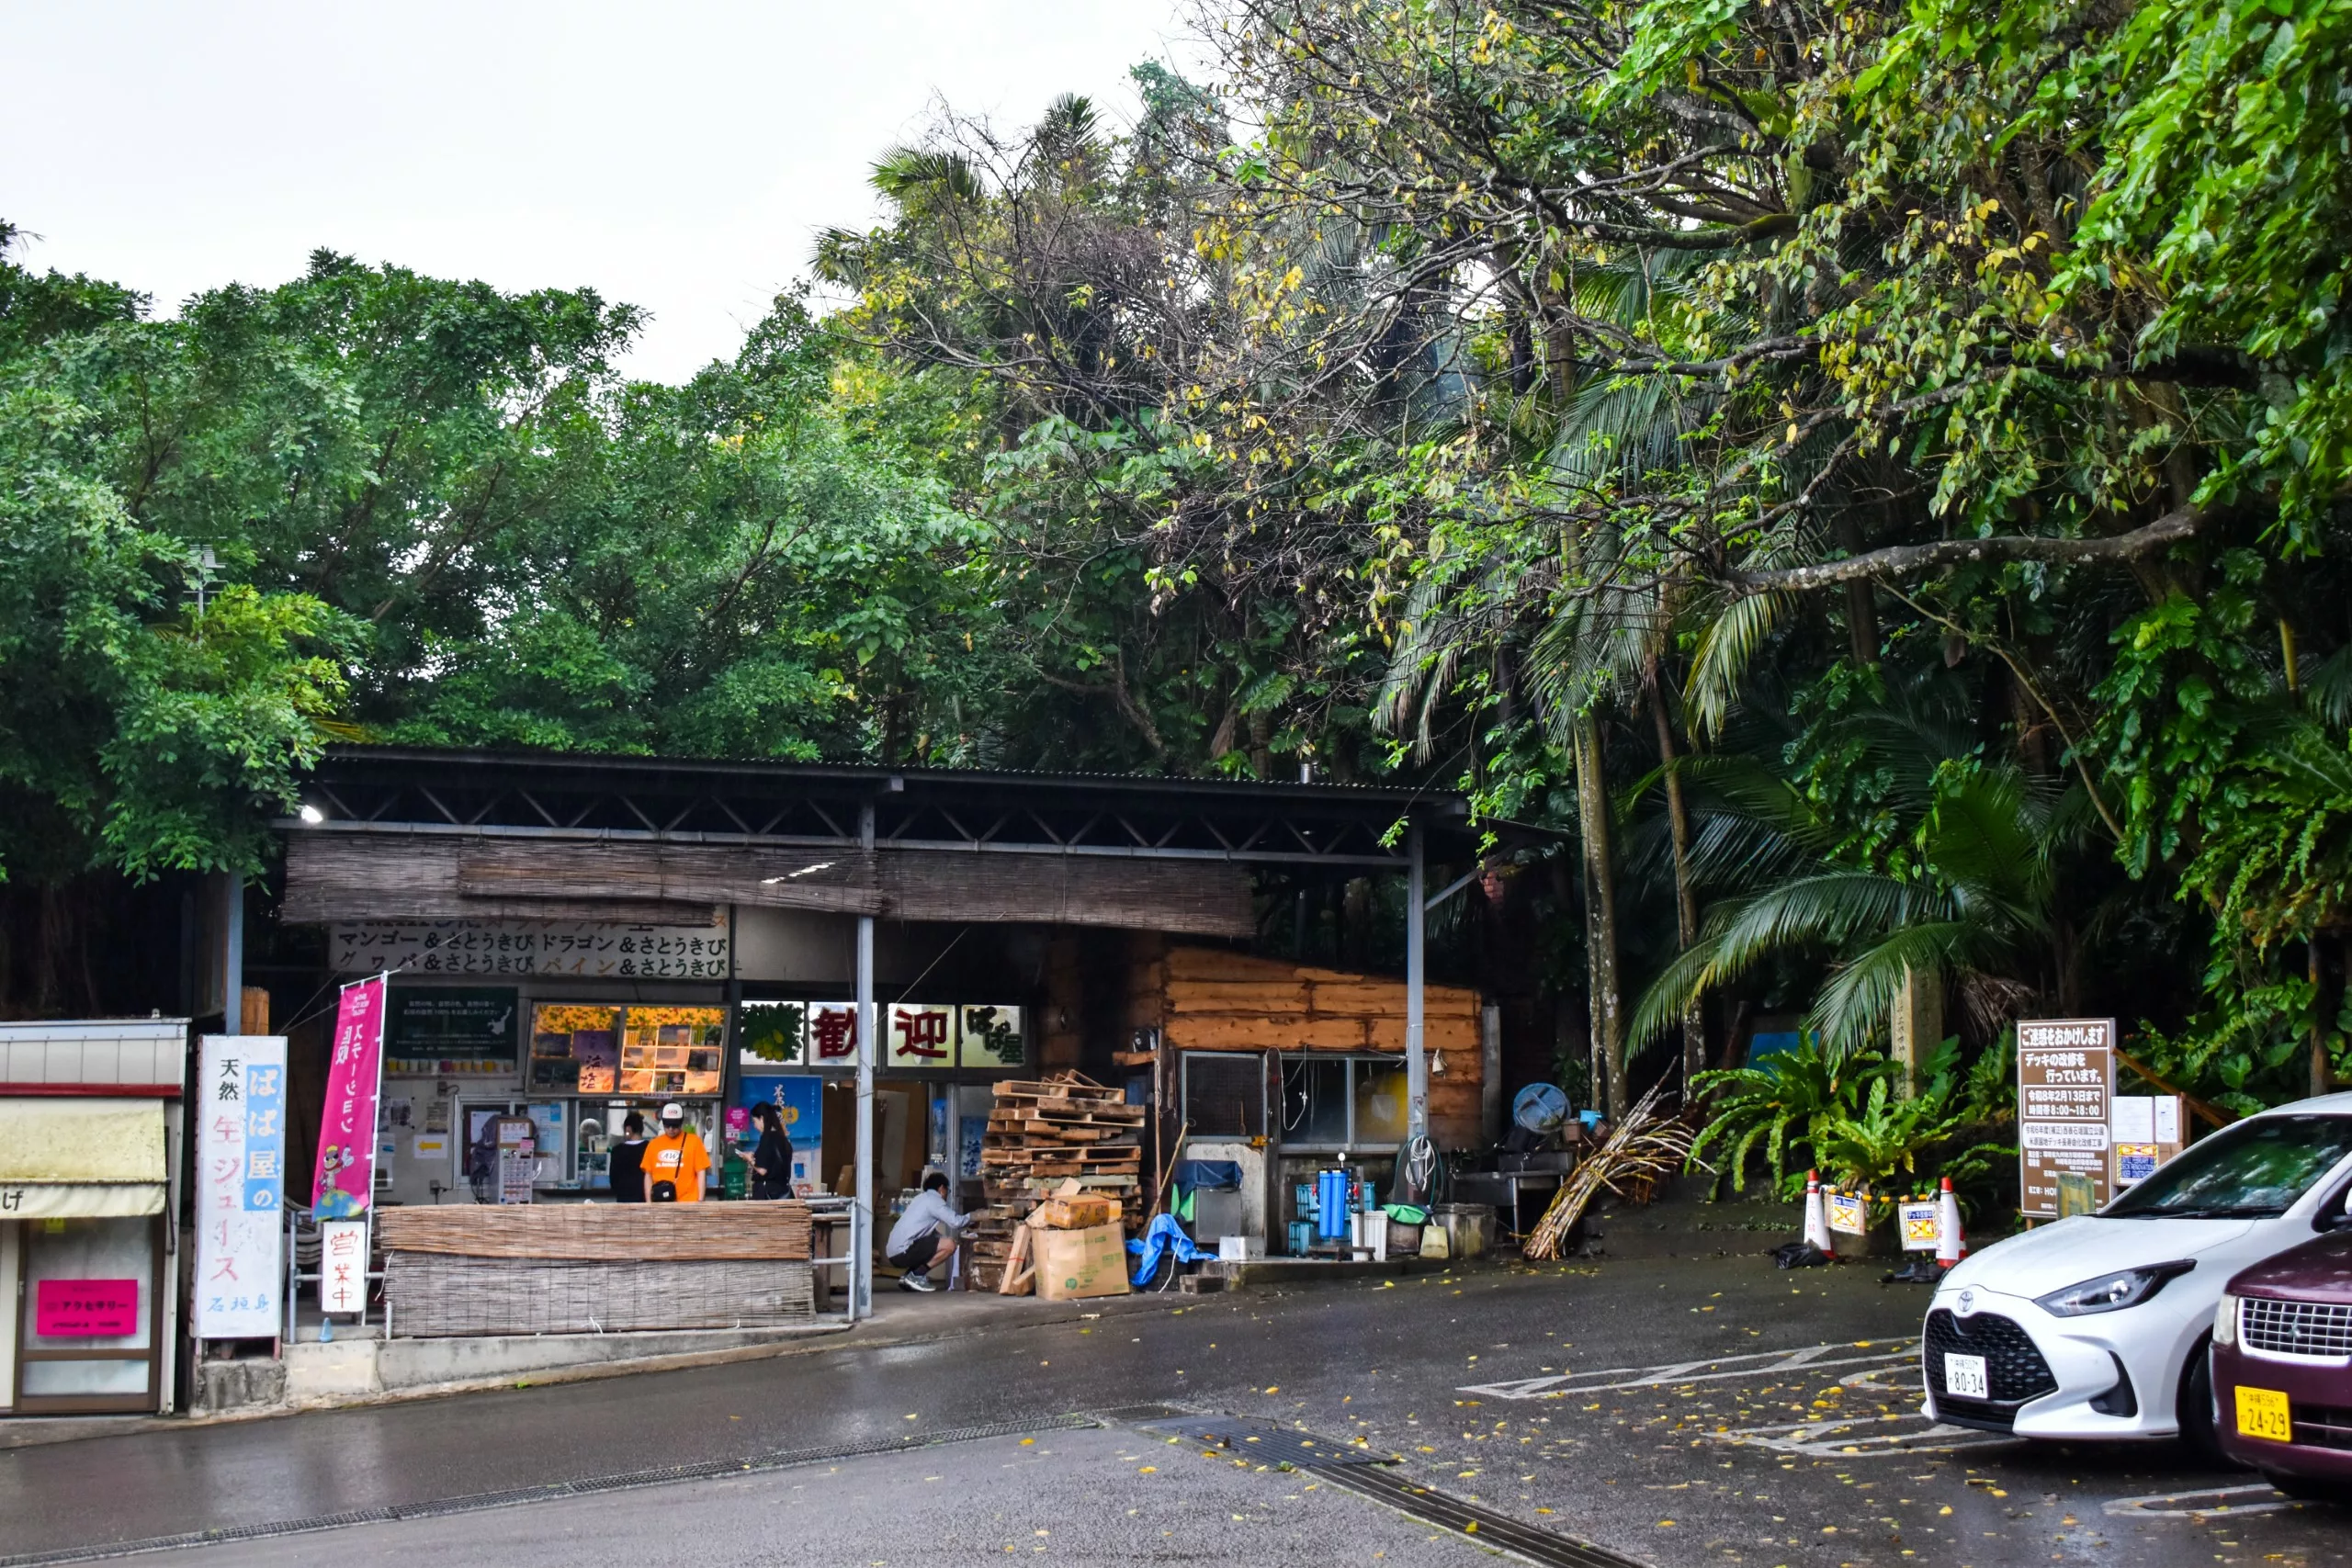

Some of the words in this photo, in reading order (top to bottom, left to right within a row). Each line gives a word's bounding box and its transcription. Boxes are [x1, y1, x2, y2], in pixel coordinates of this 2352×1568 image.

[2022, 1025, 2105, 1046] ご迷惑をおかけします
[2025, 1053, 2086, 1066] デッキの改修を
[219, 1058, 240, 1100] 天然
[2046, 1068, 2102, 1083] 行っています。
[2028, 1089, 2101, 1102] 令和8年2月13日まで
[0, 1190, 24, 1211] げ
[210, 1114, 242, 1281] 生ジュース
[330, 1230, 358, 1309] 営業中
[207, 1293, 270, 1314] 石垣島
[1954, 1371, 1984, 1394] 80-34
[2247, 1407, 2286, 1436] 24-29
